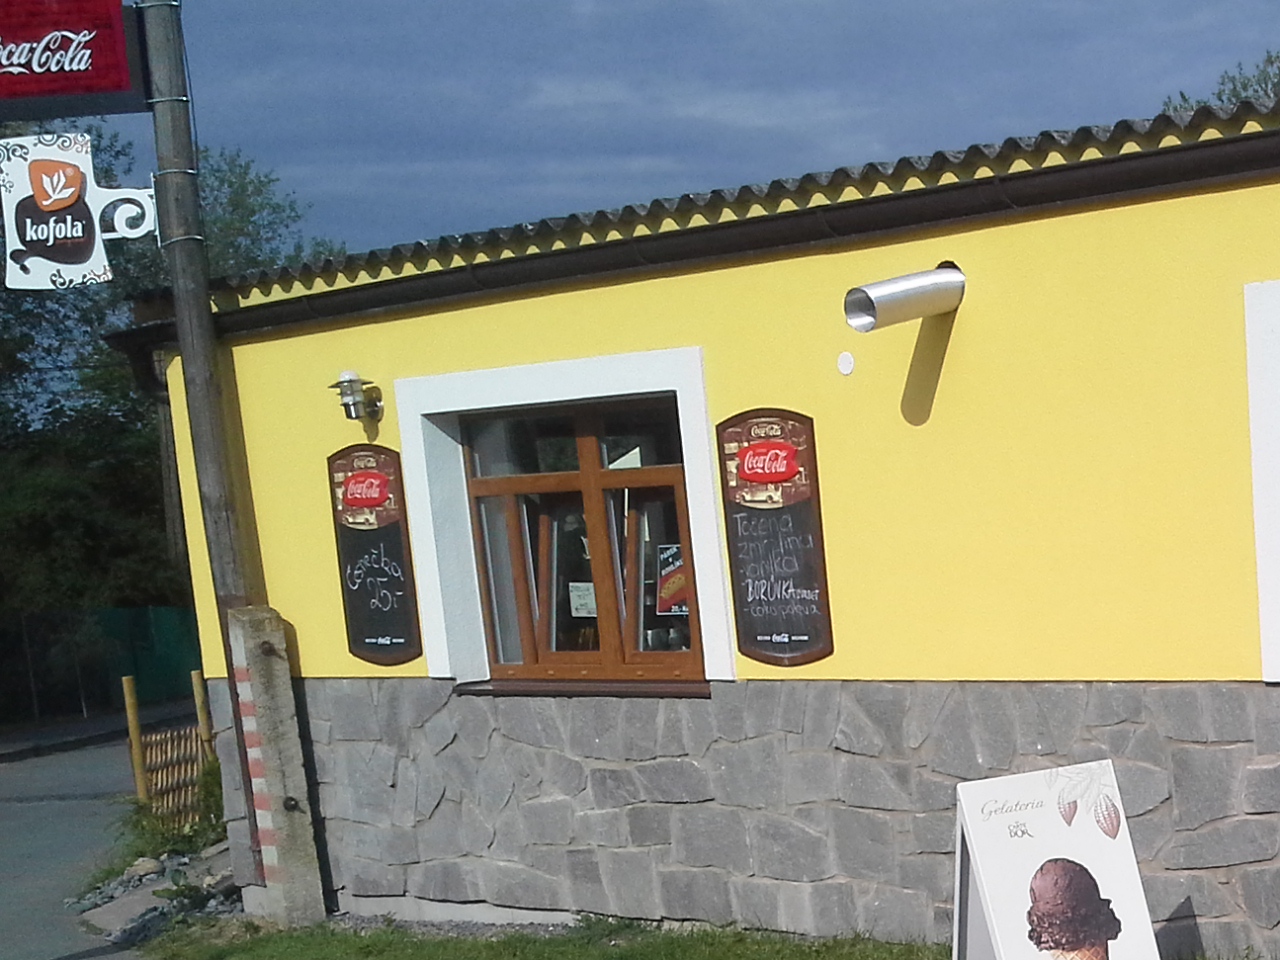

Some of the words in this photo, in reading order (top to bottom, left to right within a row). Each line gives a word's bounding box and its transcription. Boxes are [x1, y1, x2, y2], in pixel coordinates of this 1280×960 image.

[0, 30, 97, 75] ca-Cola
[25, 215, 84, 246] kofola
[744, 449, 788, 474] Coca-Cola
[347, 478, 380, 499] Coca-Cola
[981, 799, 1044, 822] Gelateria
